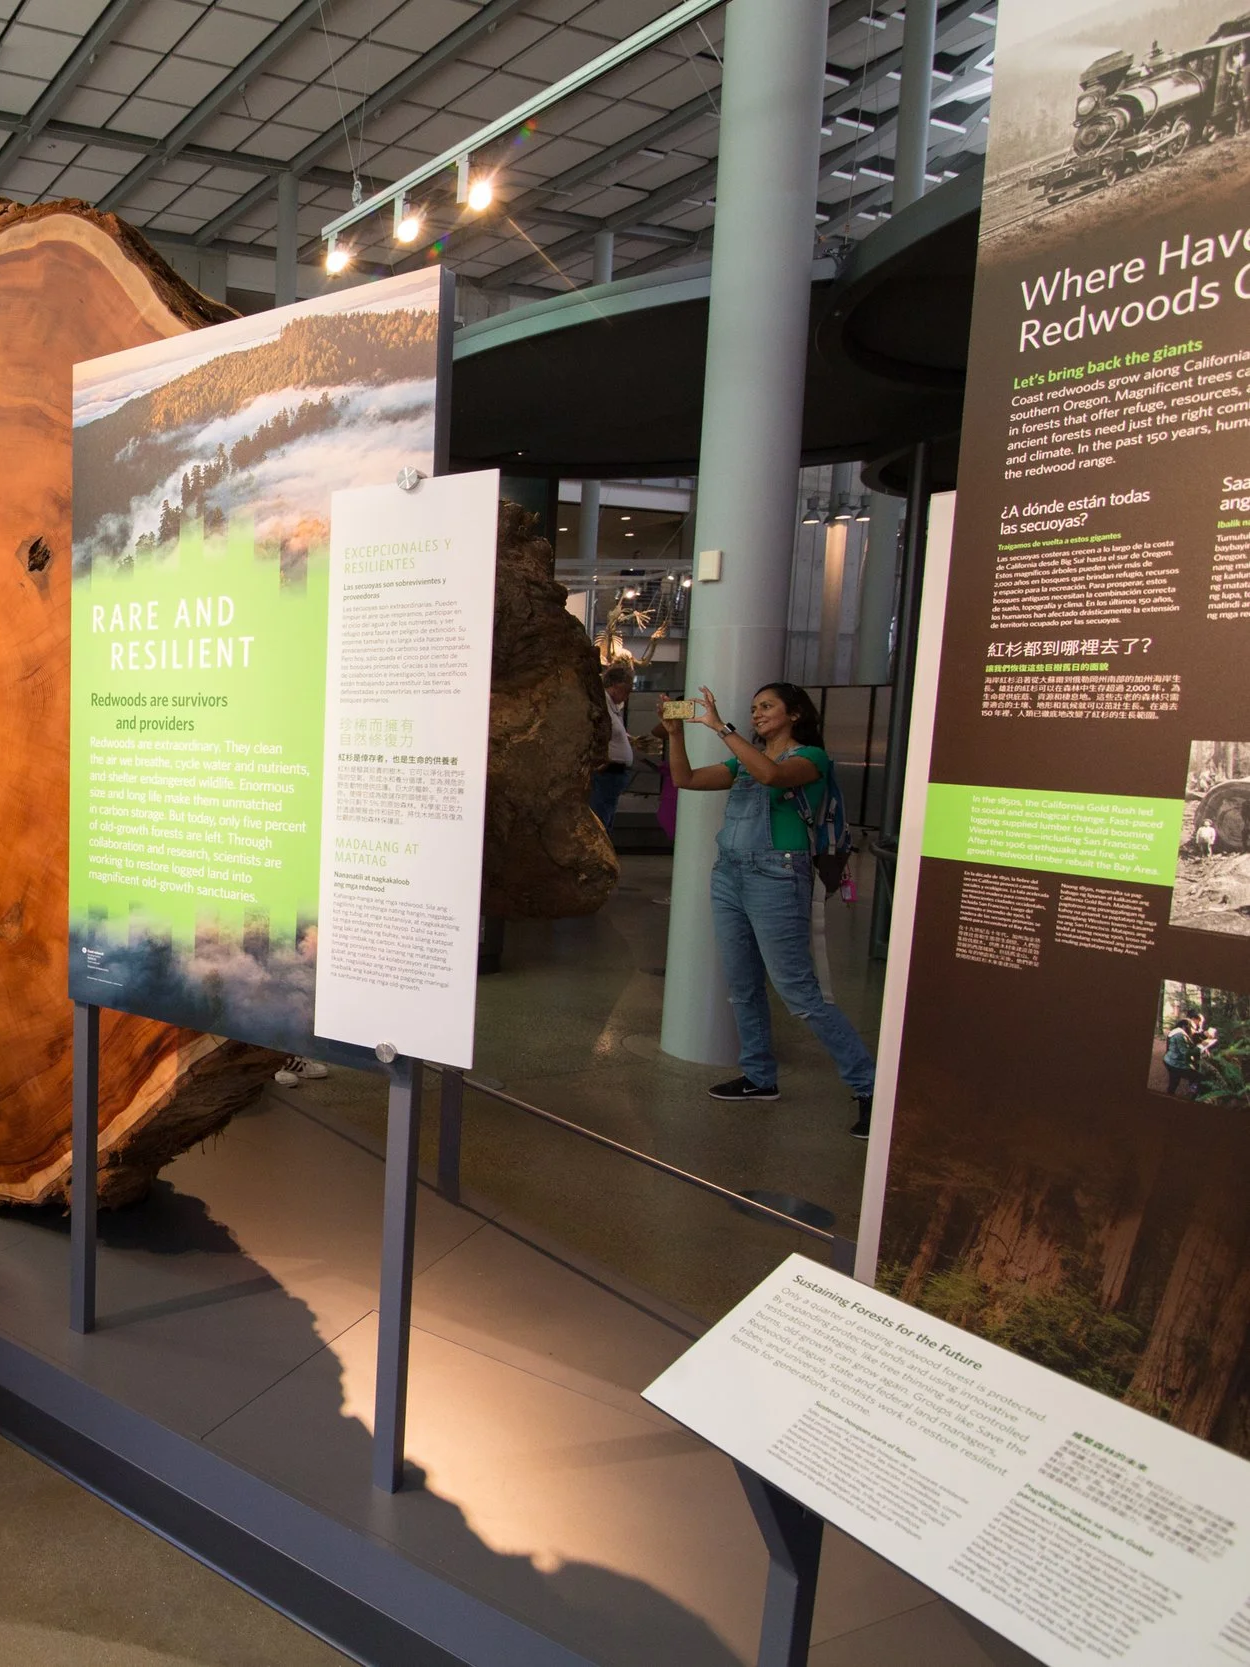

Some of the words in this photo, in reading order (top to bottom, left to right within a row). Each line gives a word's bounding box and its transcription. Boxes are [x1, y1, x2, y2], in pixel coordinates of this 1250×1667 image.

[1021, 258, 1145, 311] Where
[1020, 279, 1220, 353] Redwoods
[1048, 366, 1085, 383] bring
[1087, 356, 1121, 374] back
[1125, 352, 1150, 366] the
[1152, 341, 1203, 363] giants
[1010, 405, 1060, 422] southern
[1063, 396, 1111, 411] Oregon.
[1115, 377, 1193, 402] Magnificent
[1198, 371, 1233, 386] trees
[1011, 392, 1044, 407] Coast
[1047, 379, 1105, 400] redwoods
[1108, 374, 1141, 390] grow
[1143, 366, 1180, 381] along
[1009, 426, 1019, 436] in
[1022, 419, 1061, 434] forests
[1064, 413, 1088, 426] that
[1090, 408, 1120, 422] offer
[1123, 401, 1167, 415] refuge,
[1171, 387, 1242, 407] resources,
[1007, 435, 1048, 451] ancient
[1051, 428, 1092, 443] forests
[1095, 420, 1126, 436] need
[1128, 417, 1152, 433] just
[1156, 413, 1178, 426] the
[1181, 406, 1213, 422] right
[1006, 452, 1027, 466] and
[1029, 447, 1074, 462] climate.
[1078, 443, 1089, 454] In
[1092, 440, 1112, 452] the
[1115, 434, 1143, 450] past
[1146, 431, 1168, 445] 150
[1171, 425, 1211, 441] years,
[1005, 469, 1022, 480] the
[1025, 459, 1076, 477] redwood
[1079, 456, 1116, 469] range.
[1001, 505, 1019, 520] ¿A
[1022, 500, 1064, 517] dónde
[1067, 495, 1106, 511] están
[1110, 490, 1150, 506] todas
[1000, 522, 1018, 535] las
[1020, 513, 1088, 533] secuoyas?
[344, 539, 439, 560] EXCEPCIONALES
[444, 538, 452, 551] Y
[344, 557, 415, 574] RESILIENTES
[395, 578, 441, 587] sobrevivientes
[343, 592, 380, 602] proveedoras
[93, 601, 159, 633] RARE
[174, 596, 235, 629] AND
[111, 636, 255, 671] RESILIENT
[91, 692, 147, 707] Redwoods
[150, 696, 168, 707] are
[172, 692, 228, 708] survivors
[116, 715, 136, 730] and
[140, 716, 194, 734] providers
[90, 736, 136, 749] Redwoods
[137, 740, 153, 750] are
[224, 740, 251, 756] They
[253, 742, 283, 755] clean
[90, 753, 104, 765] the
[105, 755, 118, 766] air
[119, 757, 134, 767] we
[176, 758, 201, 771] cycle
[203, 760, 232, 772] water
[234, 761, 255, 773] and
[257, 762, 310, 777] nutrients,
[89, 770, 108, 782] and
[107, 771, 138, 784] shelter
[139, 775, 197, 788] endangered
[239, 779, 295, 794] Enormous
[90, 787, 107, 799] size
[106, 789, 125, 800] and
[126, 789, 147, 804] long
[148, 790, 162, 804] life
[164, 793, 191, 805] make
[193, 794, 220, 807] them
[222, 799, 283, 812] unmatched
[89, 805, 99, 814] in
[98, 805, 130, 817] carbon
[169, 809, 185, 823] But
[187, 812, 216, 827] today,
[219, 815, 241, 830] only
[243, 816, 263, 830] five
[265, 820, 307, 833] percent
[335, 837, 399, 854] MADALANG
[404, 843, 419, 855] AT
[335, 852, 387, 868] MATATAG
[334, 871, 364, 880] Nananatili
[371, 876, 410, 886] nagkakaloob
[334, 882, 345, 890] ang
[345, 883, 358, 891] mga
[359, 884, 385, 893] redwood
[792, 1275, 850, 1308] Sustaining
[850, 1302, 894, 1328] Forests
[895, 1324, 915, 1337] for
[916, 1333, 937, 1349] the
[938, 1344, 982, 1371] Future
[781, 1287, 802, 1301] Only
[810, 1303, 845, 1321] quarter
[845, 1320, 858, 1328] of
[856, 1325, 894, 1348] existing
[895, 1344, 943, 1370] redwood
[942, 1366, 975, 1387] forest
[976, 1383, 987, 1393] is
